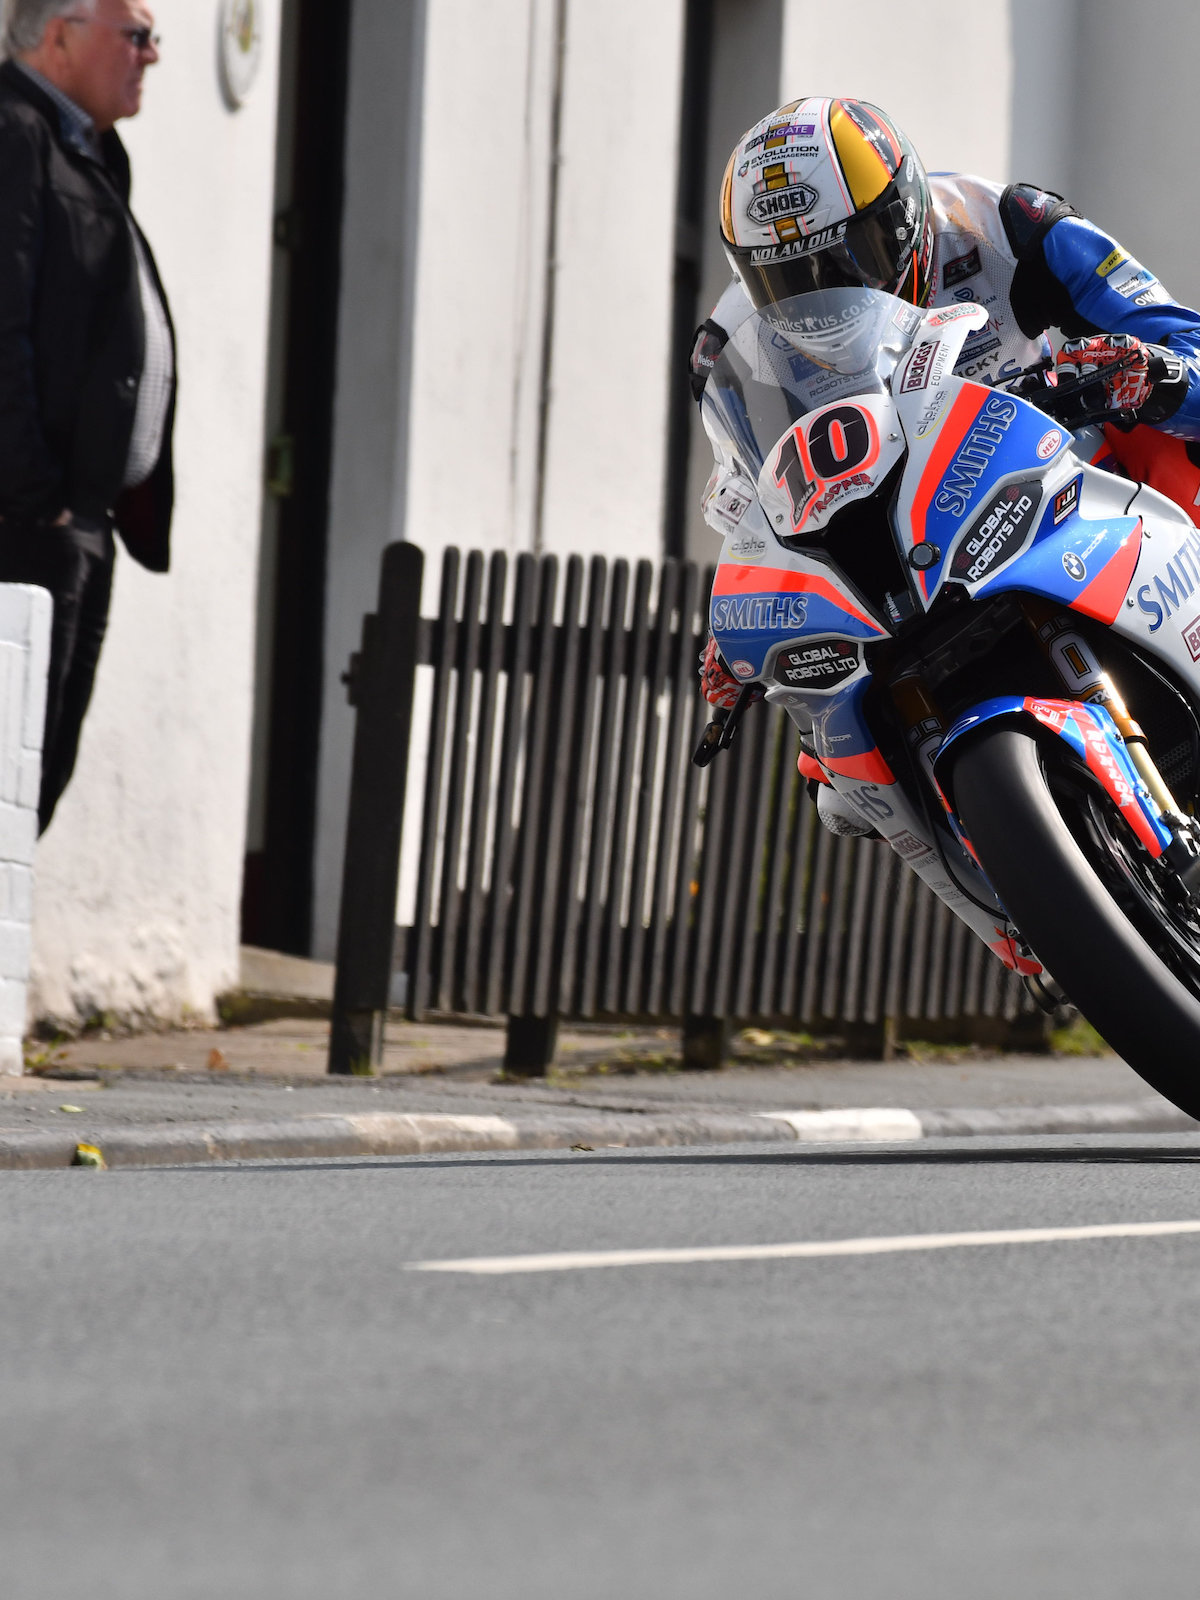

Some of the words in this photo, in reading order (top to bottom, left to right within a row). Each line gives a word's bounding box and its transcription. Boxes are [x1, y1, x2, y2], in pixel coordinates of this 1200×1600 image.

[750, 145, 819, 165] EVOLUTION
[770, 152, 819, 162] MANAGEMENT
[756, 190, 807, 219] SHOEI
[750, 240, 806, 262] NOLAN
[807, 221, 848, 249] OILS
[931, 343, 951, 387] EQUIPMENT
[915, 389, 945, 437] alpha
[934, 398, 1018, 518] SMITHS
[1042, 436, 1060, 456] HEL
[772, 404, 881, 530] 10
[808, 472, 876, 523] TROOPER
[965, 498, 1014, 558] GLOBAL
[966, 520, 1015, 582] ROBOTS
[1012, 494, 1033, 527] LTD
[713, 597, 809, 632] SMITHS
[735, 665, 752, 676] HEL
[784, 663, 835, 682] ROBOTS
[835, 657, 858, 673] LTD
[788, 644, 840, 667] GLOBAL
